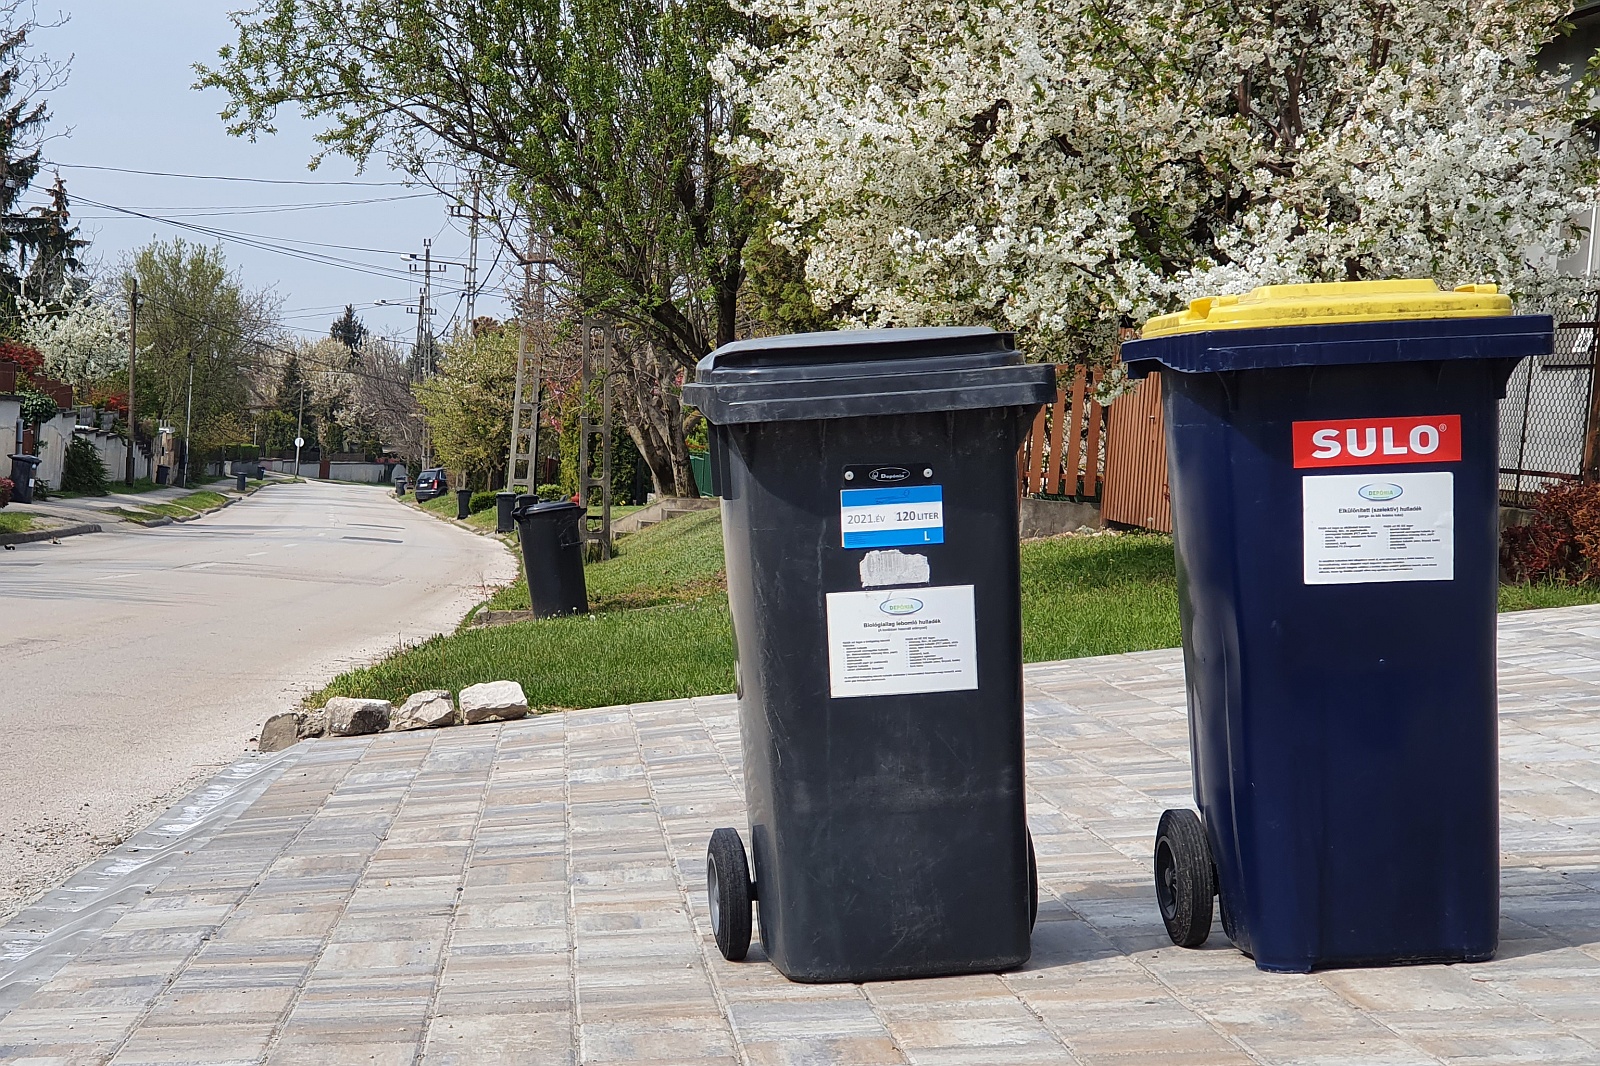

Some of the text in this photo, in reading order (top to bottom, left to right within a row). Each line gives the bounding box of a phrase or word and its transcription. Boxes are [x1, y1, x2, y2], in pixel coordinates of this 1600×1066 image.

[896, 511, 916, 522] 120
[917, 512, 939, 521] LITER
[923, 530, 931, 541] L
